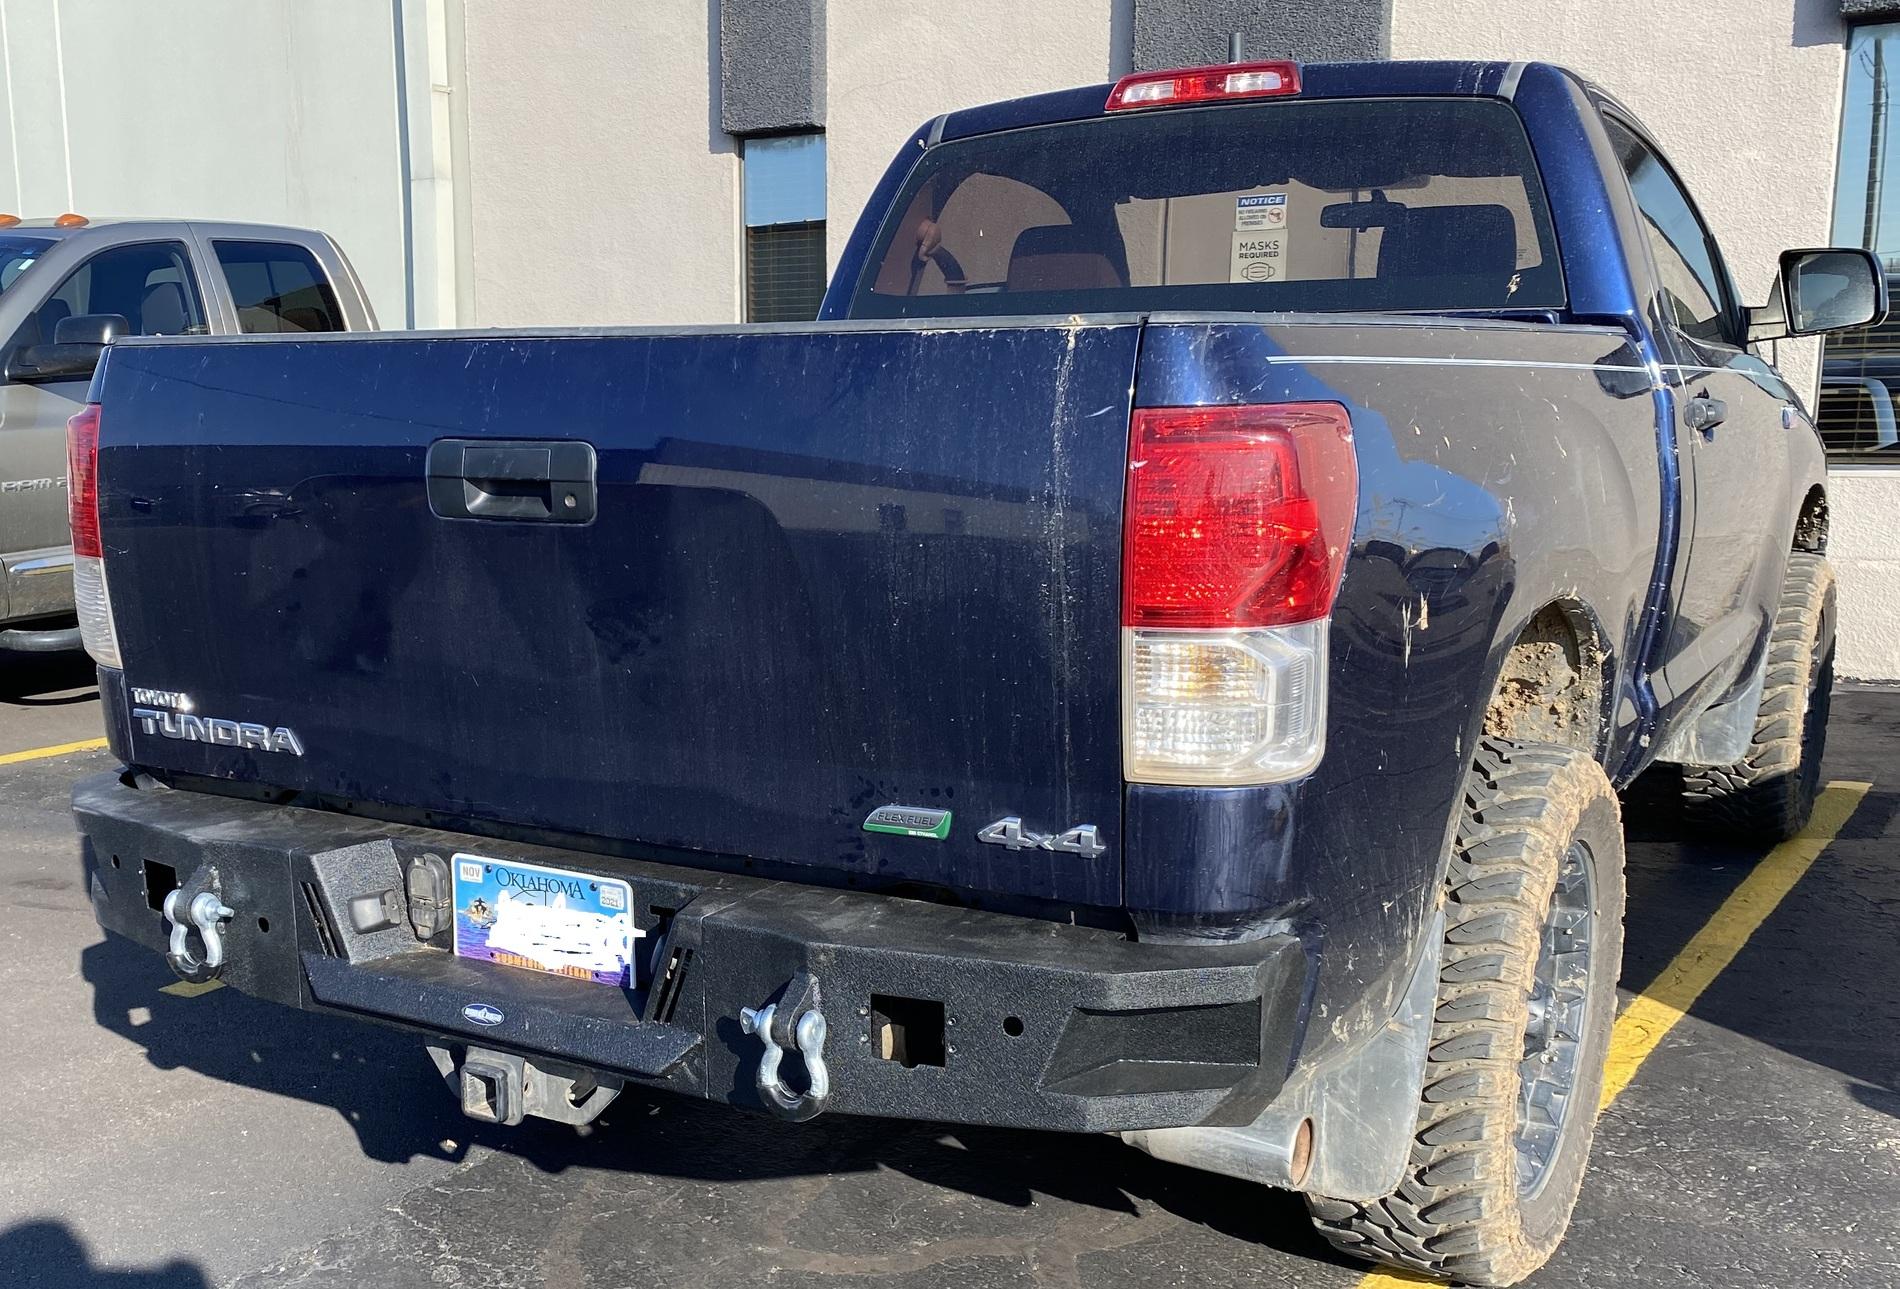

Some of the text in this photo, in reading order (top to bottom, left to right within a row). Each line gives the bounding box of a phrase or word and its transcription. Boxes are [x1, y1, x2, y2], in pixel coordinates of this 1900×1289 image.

[1240, 196, 1284, 206] NOTICE
[1239, 240, 1280, 251] MASKS
[1238, 251, 1279, 259] REQUIRED
[131, 687, 193, 711] TOYOTA
[133, 708, 305, 757] TUNDRA
[876, 811, 936, 827] FLEX FUEL
[462, 864, 481, 878] NOV
[495, 867, 586, 900] OKLAHOMA
[601, 896, 619, 908] 2021
